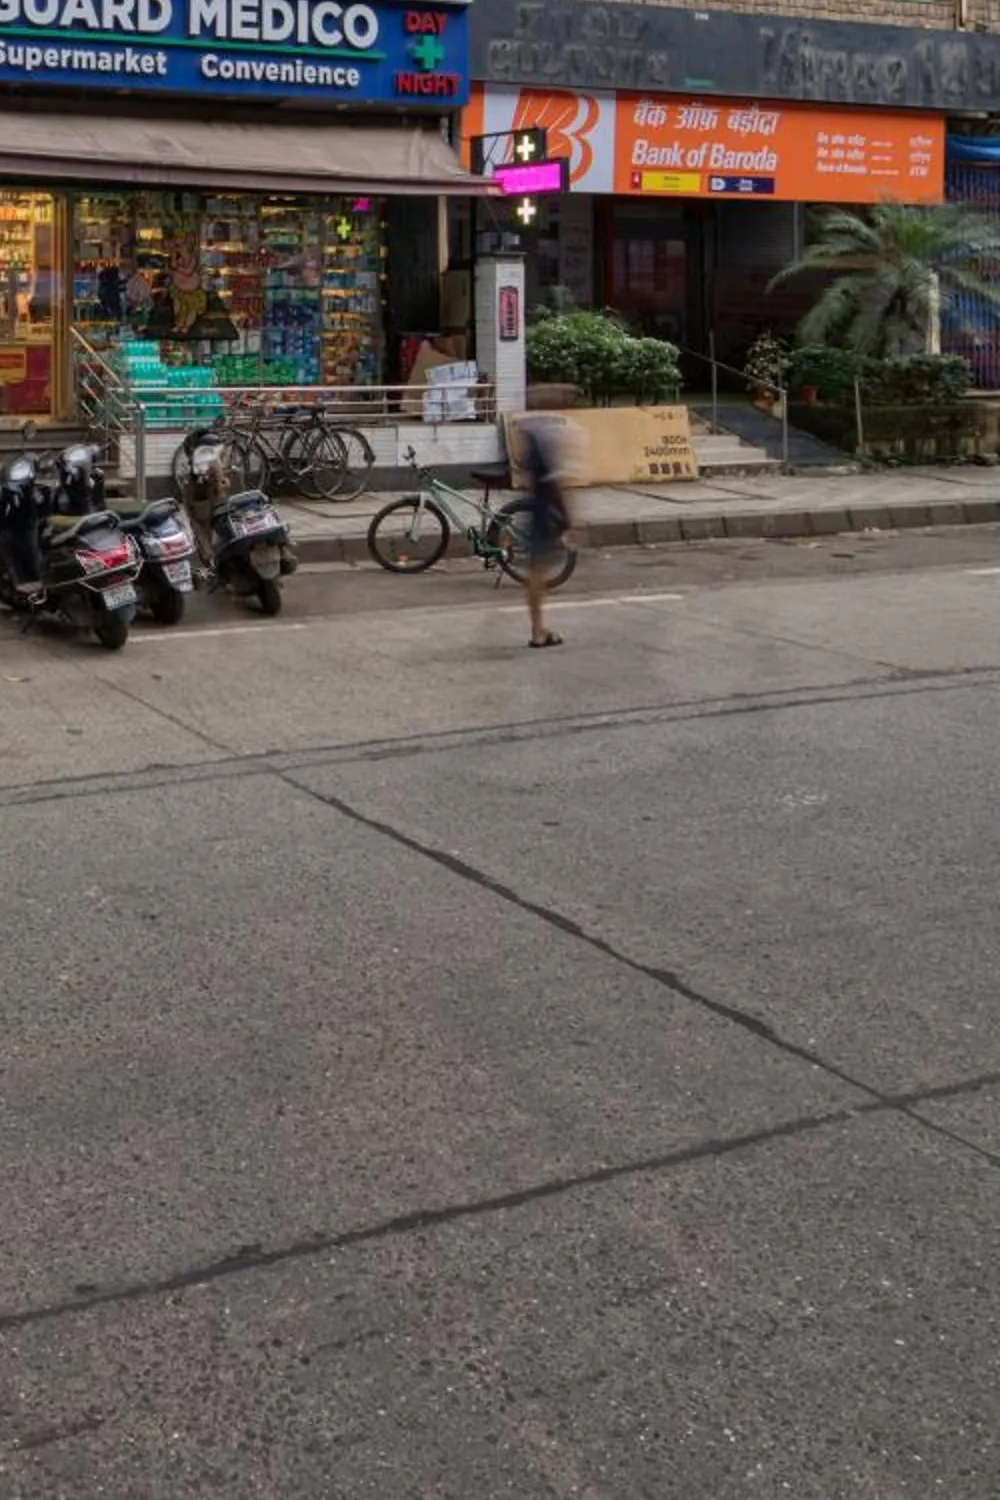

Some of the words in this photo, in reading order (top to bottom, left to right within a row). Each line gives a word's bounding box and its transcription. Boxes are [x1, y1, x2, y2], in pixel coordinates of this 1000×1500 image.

[406, 11, 447, 34] DAY
[201, 54, 361, 87] Convenience
[396, 73, 460, 96] NIGHT
[632, 138, 682, 166] Bank
[686, 143, 708, 168] of
[709, 143, 778, 171] Baroda
